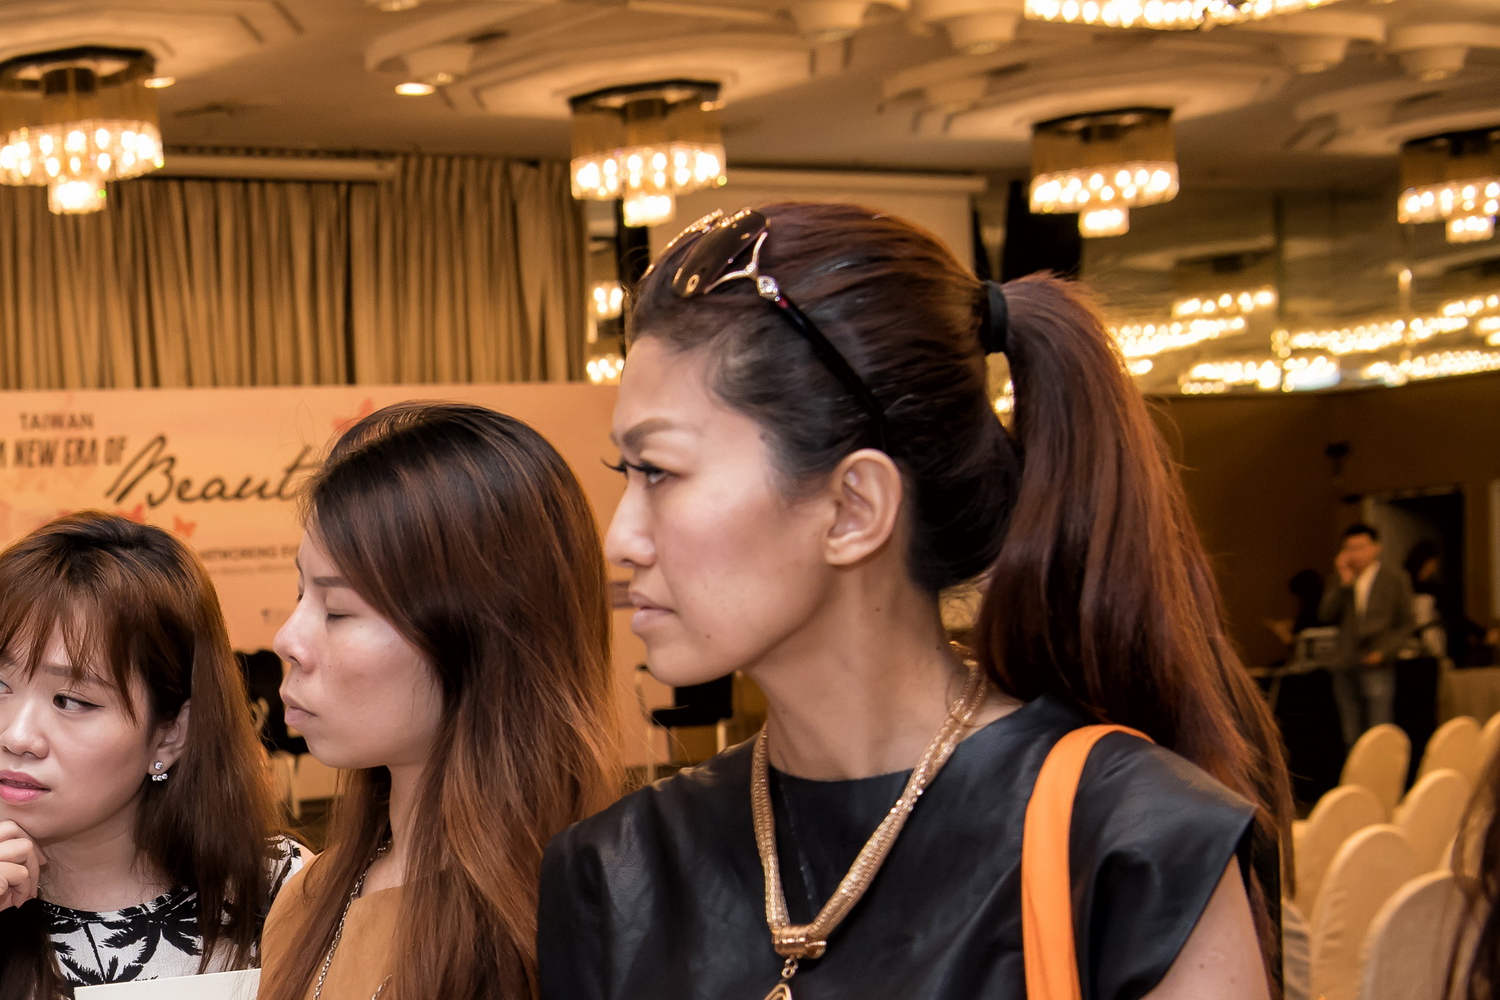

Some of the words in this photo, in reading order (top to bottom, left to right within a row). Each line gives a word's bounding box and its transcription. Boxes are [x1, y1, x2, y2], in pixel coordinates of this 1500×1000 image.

[19, 412, 95, 430] TAIWAN
[13, 439, 58, 468] NEW
[64, 437, 98, 467] ERA
[104, 435, 127, 466] OF
[105, 434, 324, 507] Beaut
